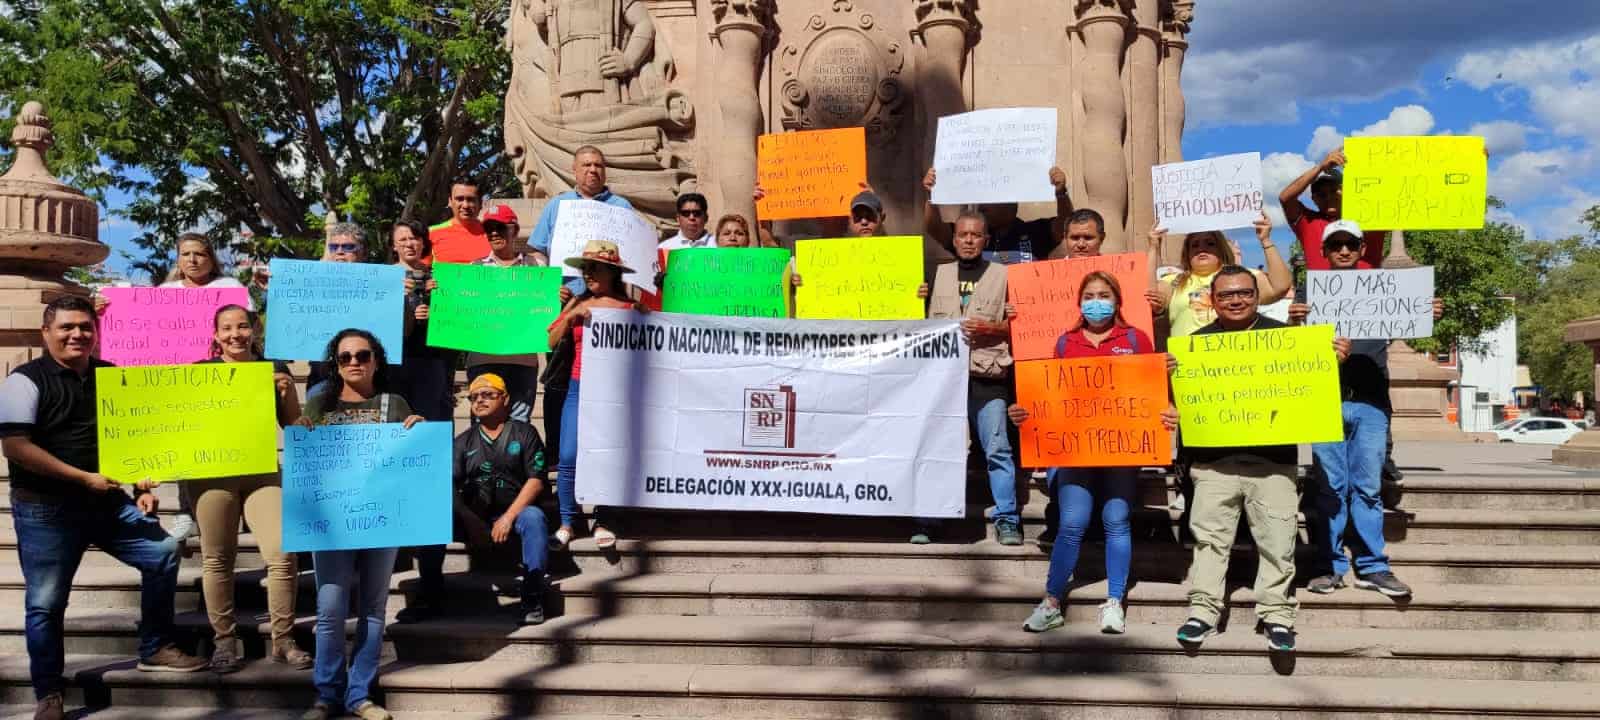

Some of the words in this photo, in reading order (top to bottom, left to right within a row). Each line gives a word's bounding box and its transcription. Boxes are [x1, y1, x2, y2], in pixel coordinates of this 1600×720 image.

[1156, 160, 1219, 185] JUSTICIA
[1154, 190, 1264, 220] PERIODISTAS
[1312, 274, 1343, 297] NO
[1354, 271, 1397, 296] MÁS
[1311, 296, 1433, 317] AGRESIONES
[591, 321, 665, 351] SINDICATO
[668, 326, 738, 356] NACIONAL
[743, 331, 761, 356] DE
[764, 332, 855, 358] REDACTORES
[903, 331, 960, 359] PRENSA
[1175, 360, 1257, 380] Esclarecer
[1264, 352, 1332, 376] atentado
[750, 391, 776, 408] SN
[1180, 387, 1226, 406] contra
[1232, 381, 1313, 405] periodistas
[102, 397, 126, 418] No
[757, 411, 783, 427] RP
[1063, 397, 1152, 419] DISPARES
[1192, 410, 1209, 425] de
[104, 427, 121, 440] Ni
[321, 429, 381, 441] LIBERTAD
[1084, 427, 1159, 461] PRENSA!
[122, 451, 178, 476] SNRP
[645, 474, 744, 497] DELEGACIÓN
[749, 480, 850, 503] XXX-IGUALA,
[853, 483, 893, 503] GRO.
